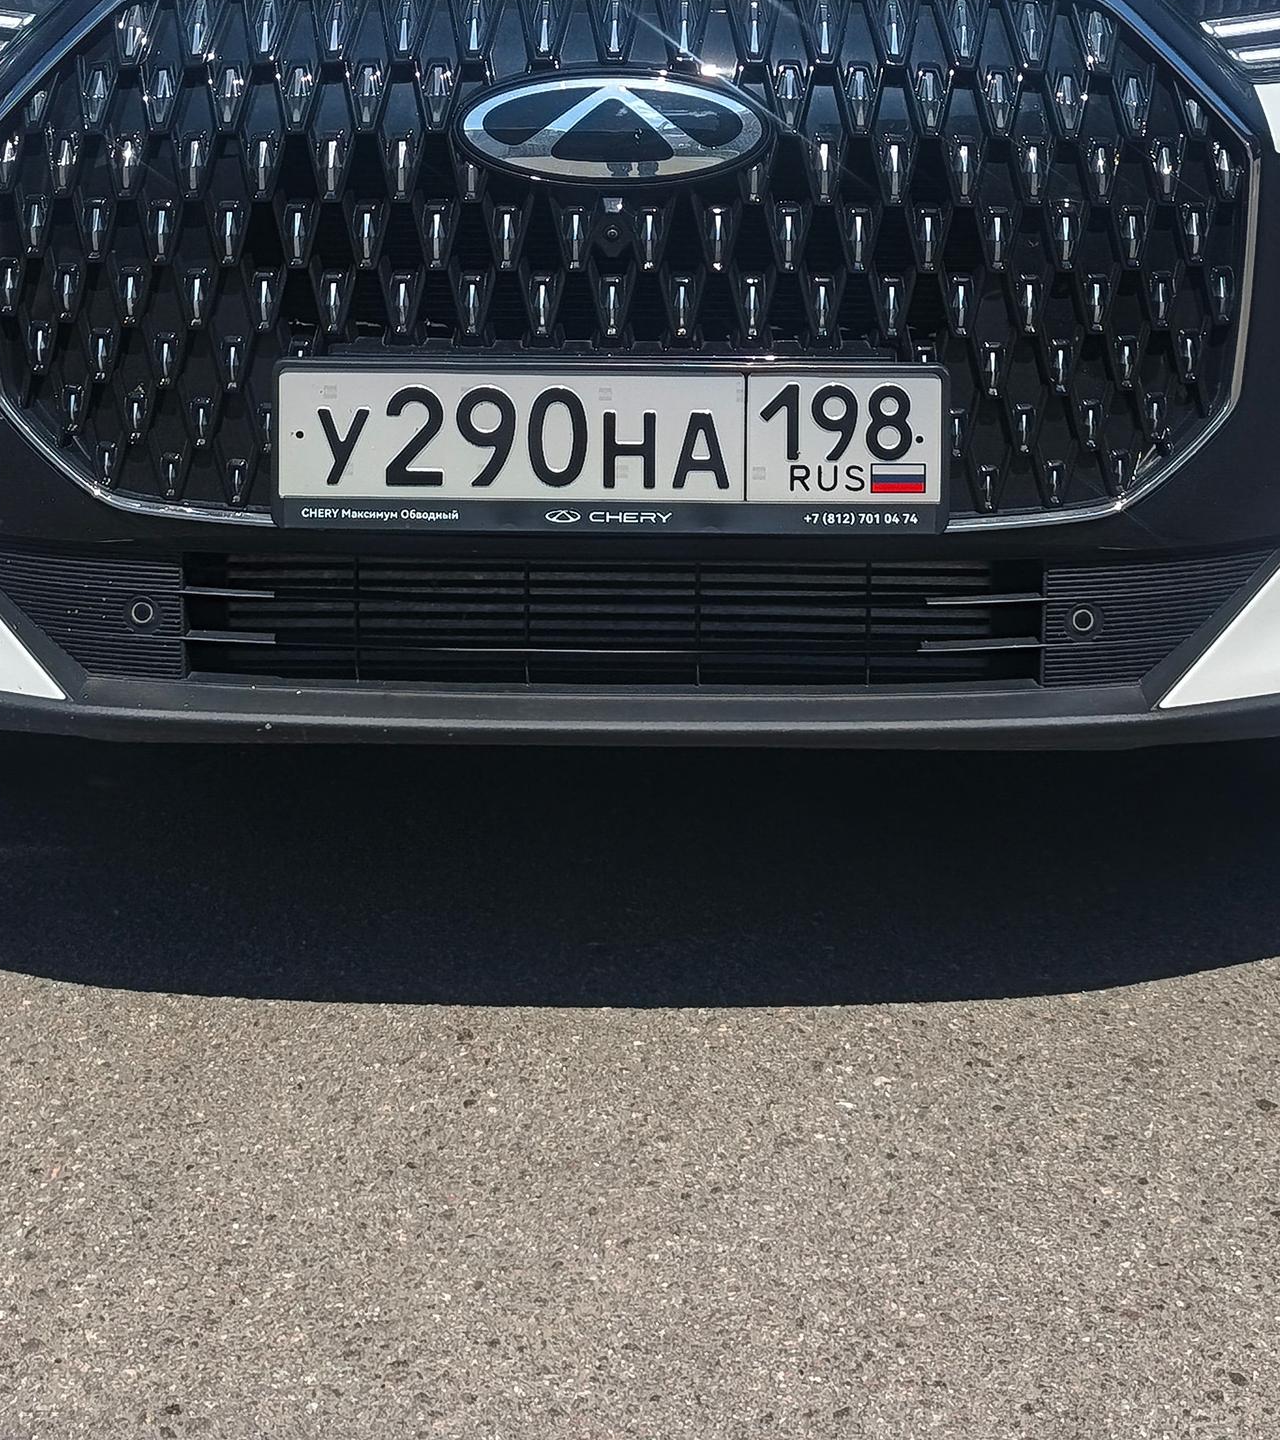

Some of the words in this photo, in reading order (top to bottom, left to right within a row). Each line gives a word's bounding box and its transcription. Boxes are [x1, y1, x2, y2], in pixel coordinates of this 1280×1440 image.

[759, 383, 913, 461] 198
[789, 464, 866, 492] RUS
[301, 507, 340, 519] CHERY
[341, 508, 399, 522] Максимум
[400, 509, 460, 521] Обводный
[588, 511, 673, 523] CHERY
[803, 513, 820, 524] +7
[822, 512, 856, 526] (812)
[858, 513, 880, 525] 701
[884, 513, 900, 525] 04
[902, 513, 919, 525] 74
